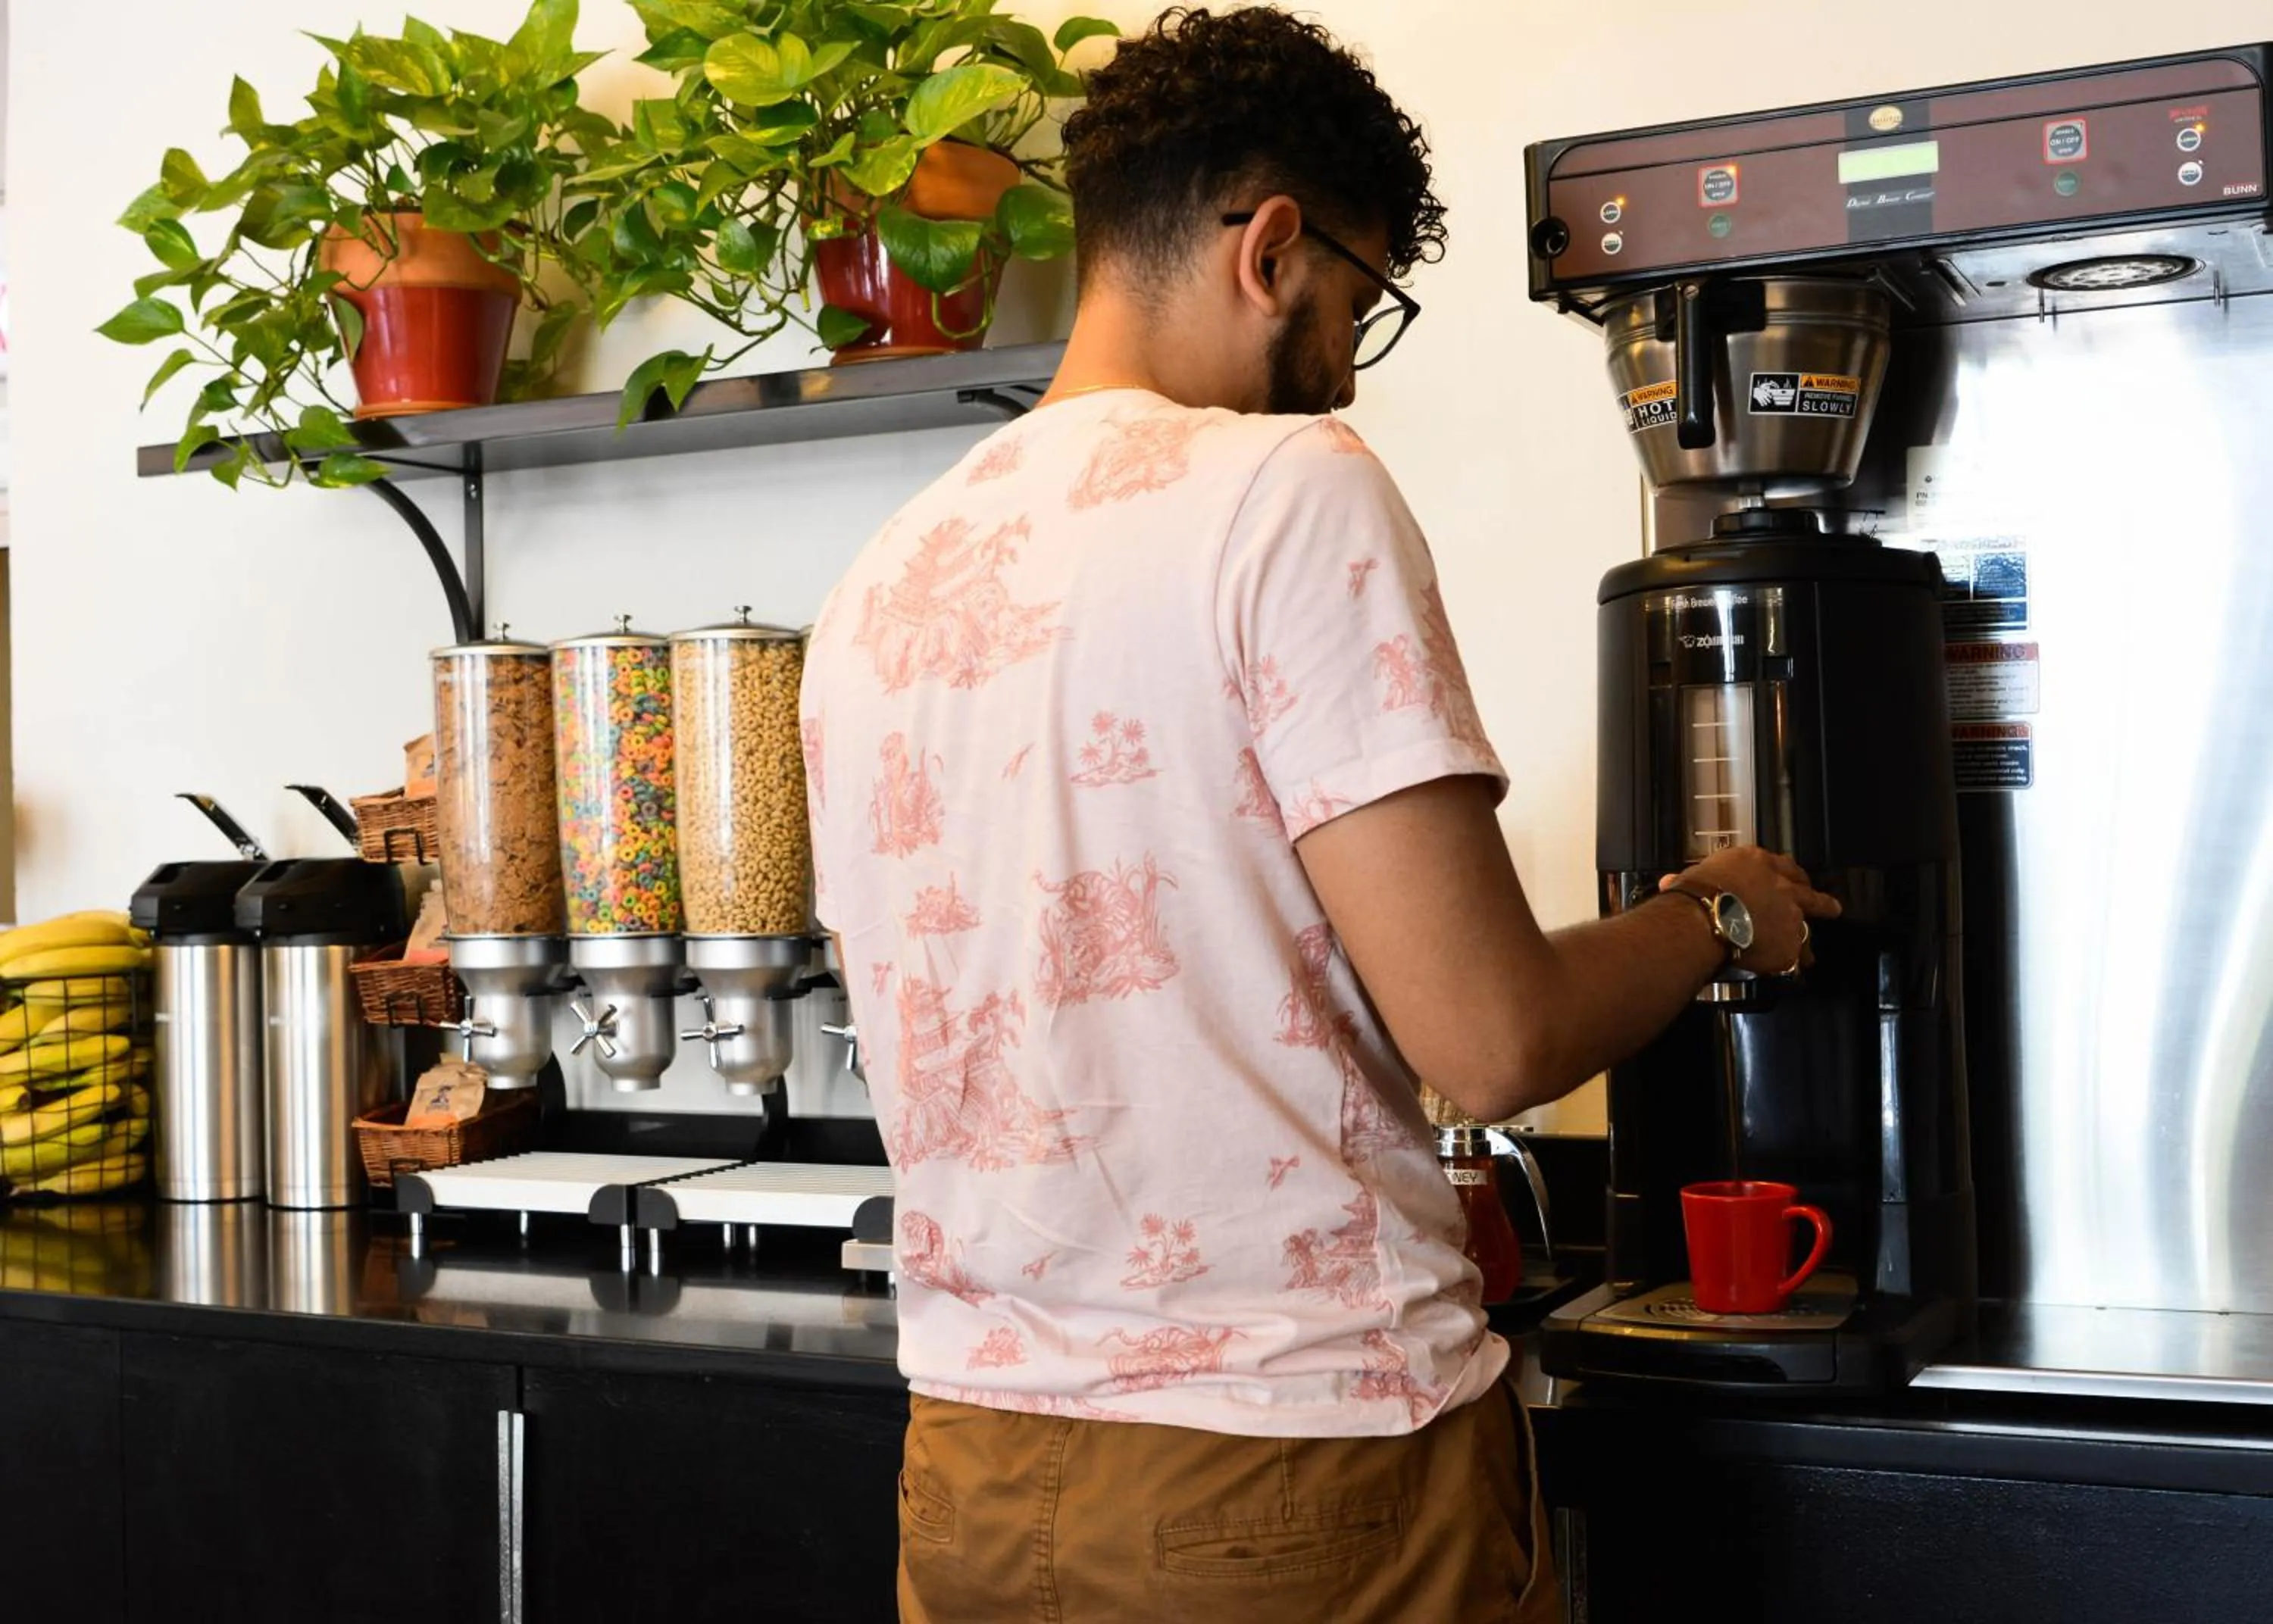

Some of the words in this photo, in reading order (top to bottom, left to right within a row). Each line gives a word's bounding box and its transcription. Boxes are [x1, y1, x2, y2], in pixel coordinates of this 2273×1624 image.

[2222, 183, 2257, 196] BUNN
[1817, 377, 1856, 389] WARNING
[1638, 386, 1673, 399] WARNING
[1638, 400, 1674, 417] HOT
[1802, 400, 1852, 413] SLOWLY
